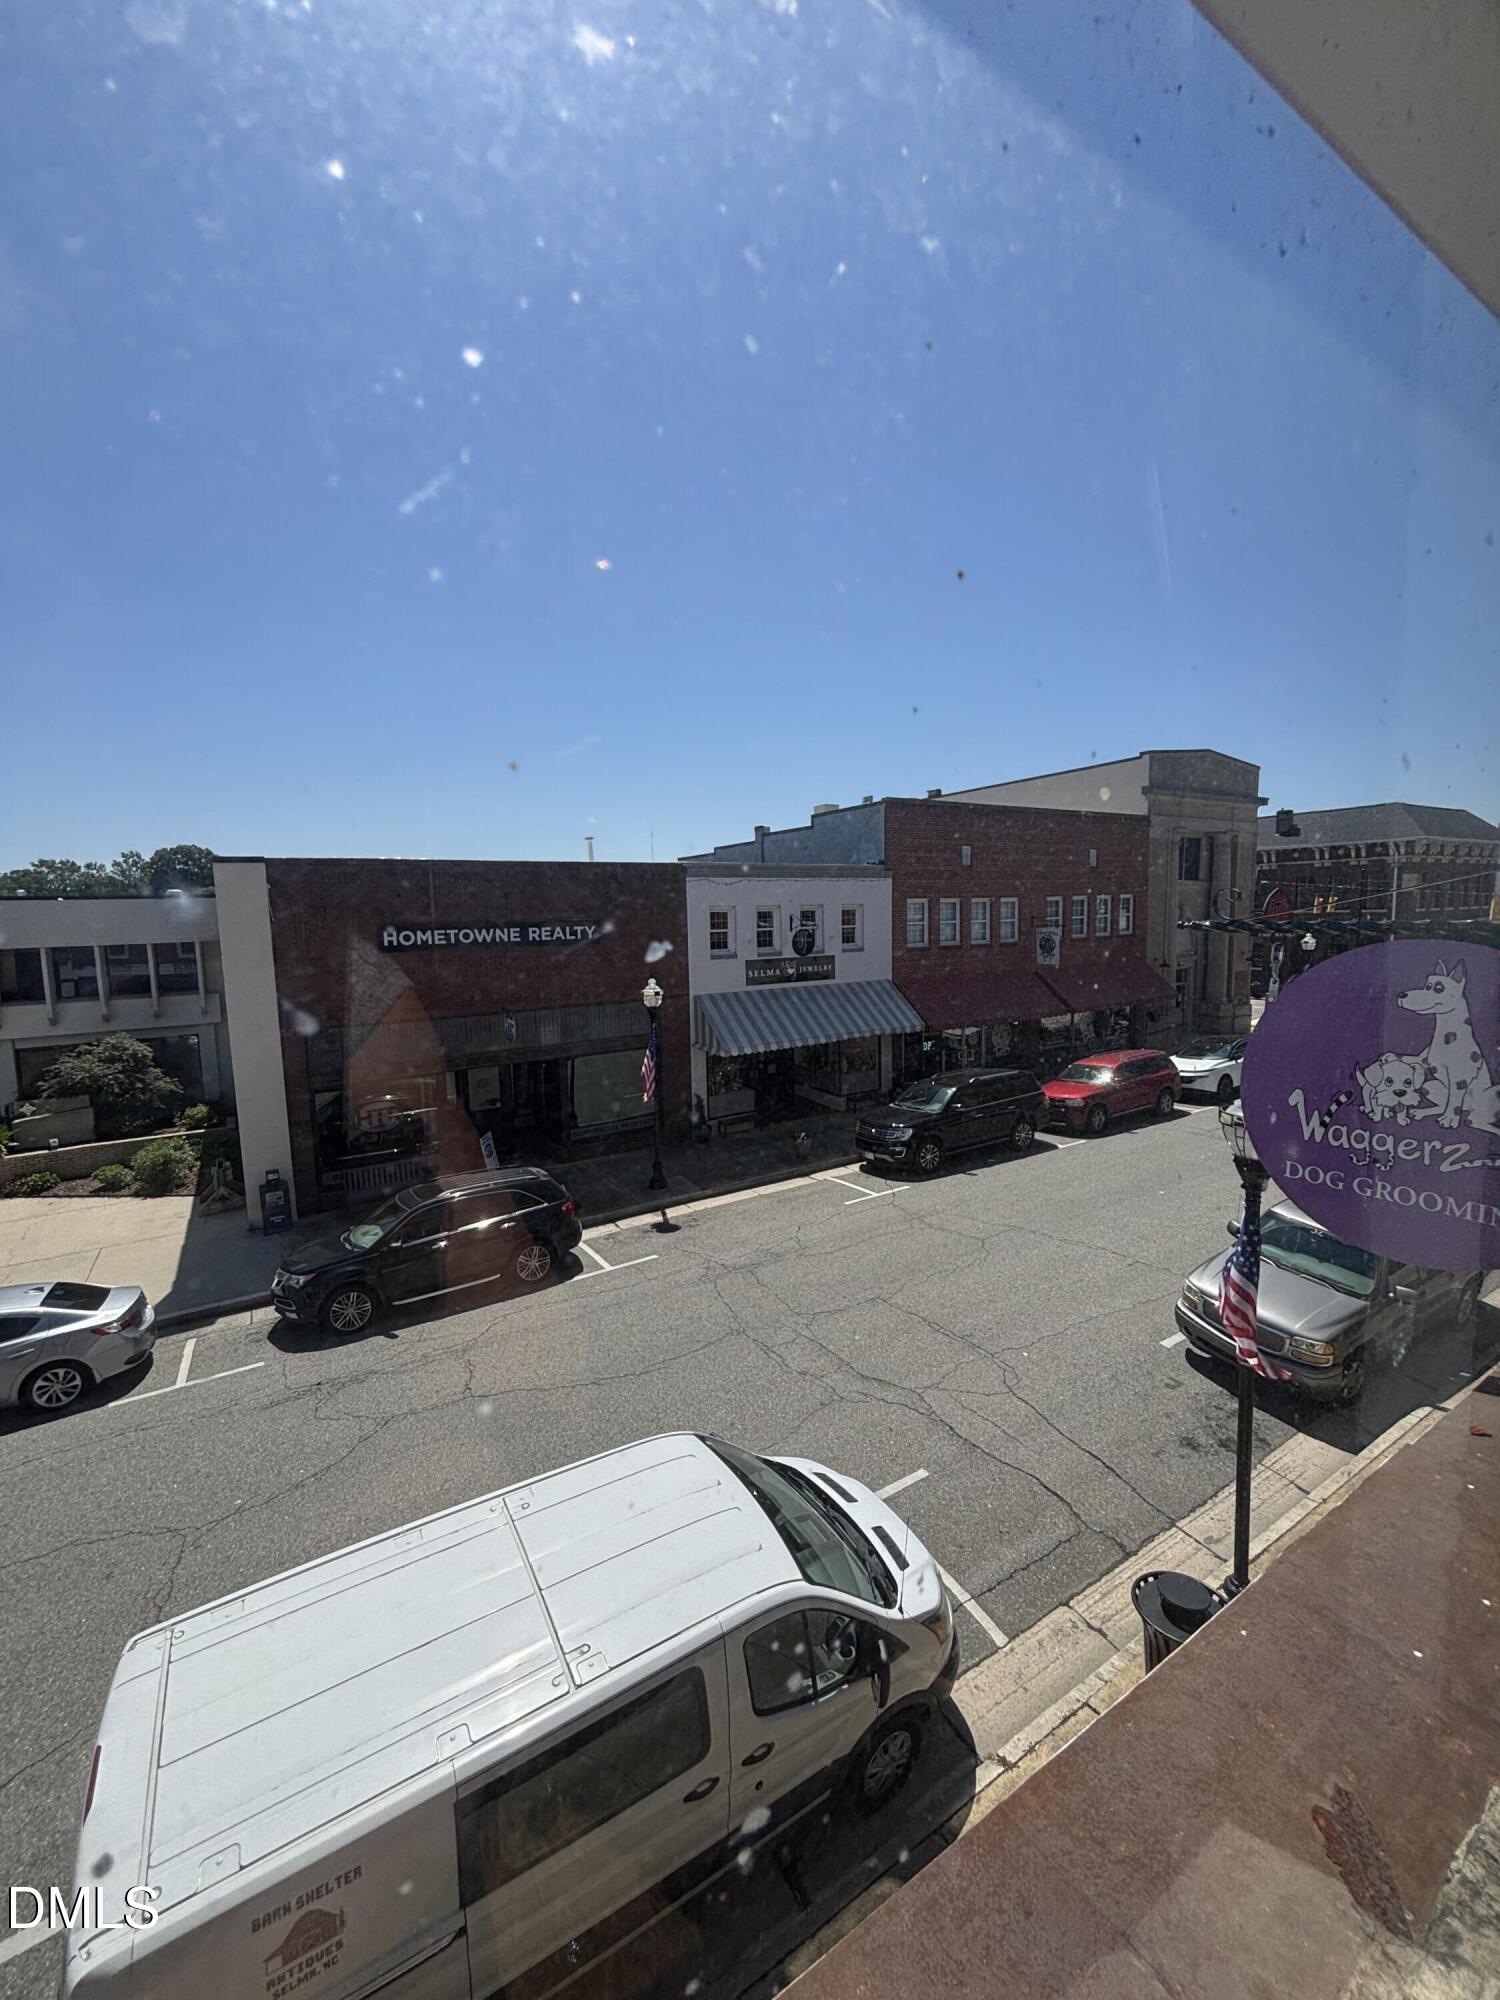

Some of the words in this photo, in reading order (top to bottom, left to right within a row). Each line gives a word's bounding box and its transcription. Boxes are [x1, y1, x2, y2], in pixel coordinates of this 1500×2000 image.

[383, 926, 521, 947] HOMETOWNE
[528, 925, 596, 941] REALTY
[748, 968, 780, 978] SELMA
[799, 964, 833, 974] JEWELRY
[1288, 1088, 1500, 1173] Waggerz
[1284, 1160, 1345, 1190] DOG
[251, 1901, 292, 1934] BARN
[295, 1865, 362, 1910] SHELTER
[265, 1938, 344, 1992] ANTIQUES
